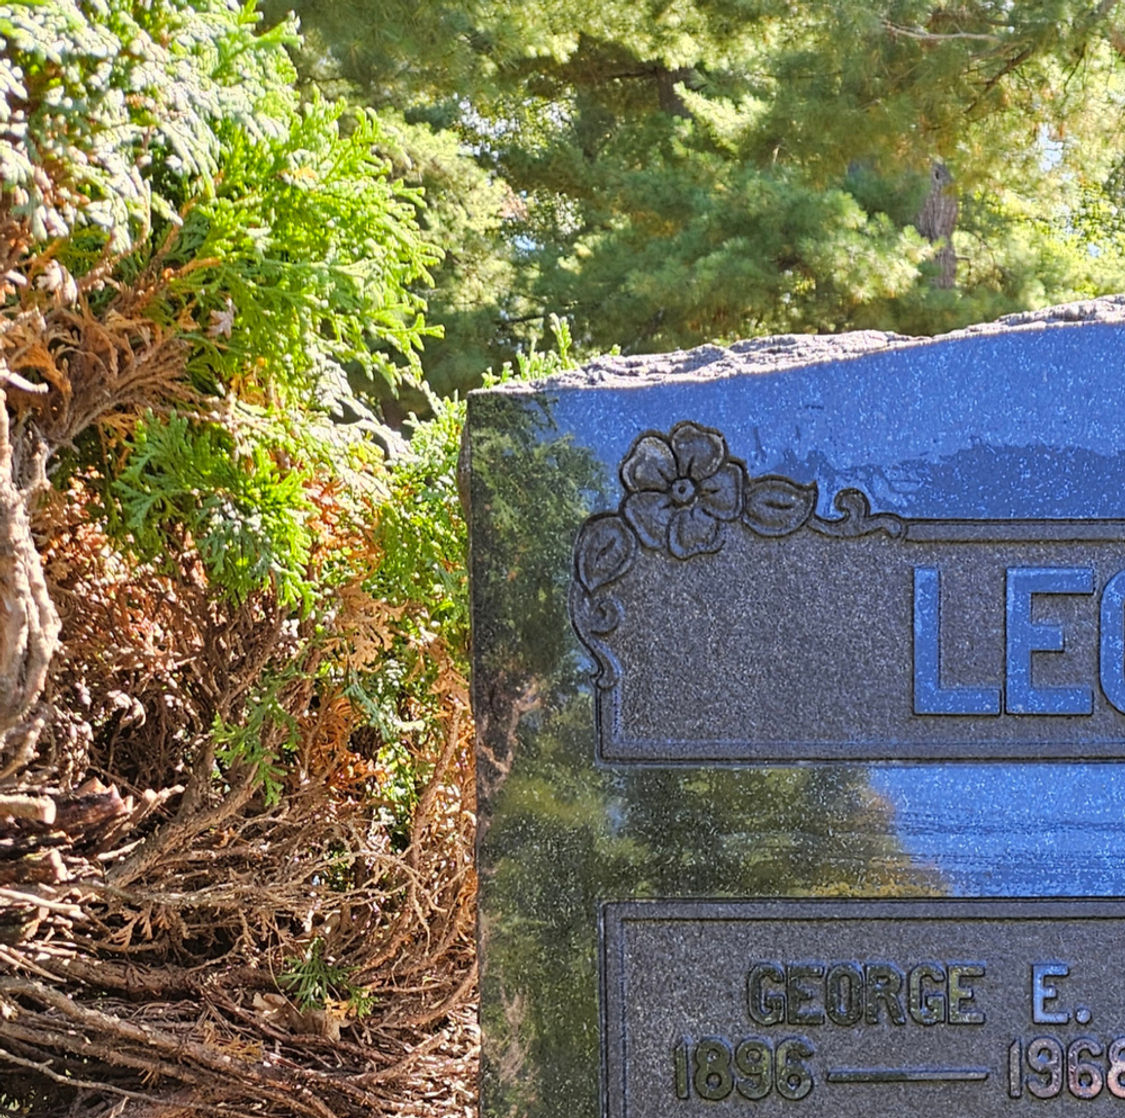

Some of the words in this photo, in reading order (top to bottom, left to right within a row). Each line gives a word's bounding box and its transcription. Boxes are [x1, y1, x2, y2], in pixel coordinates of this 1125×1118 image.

[746, 960, 987, 1028] GEORGE
[1030, 961, 1094, 1026] E.
[673, 1036, 815, 1101] 1896
